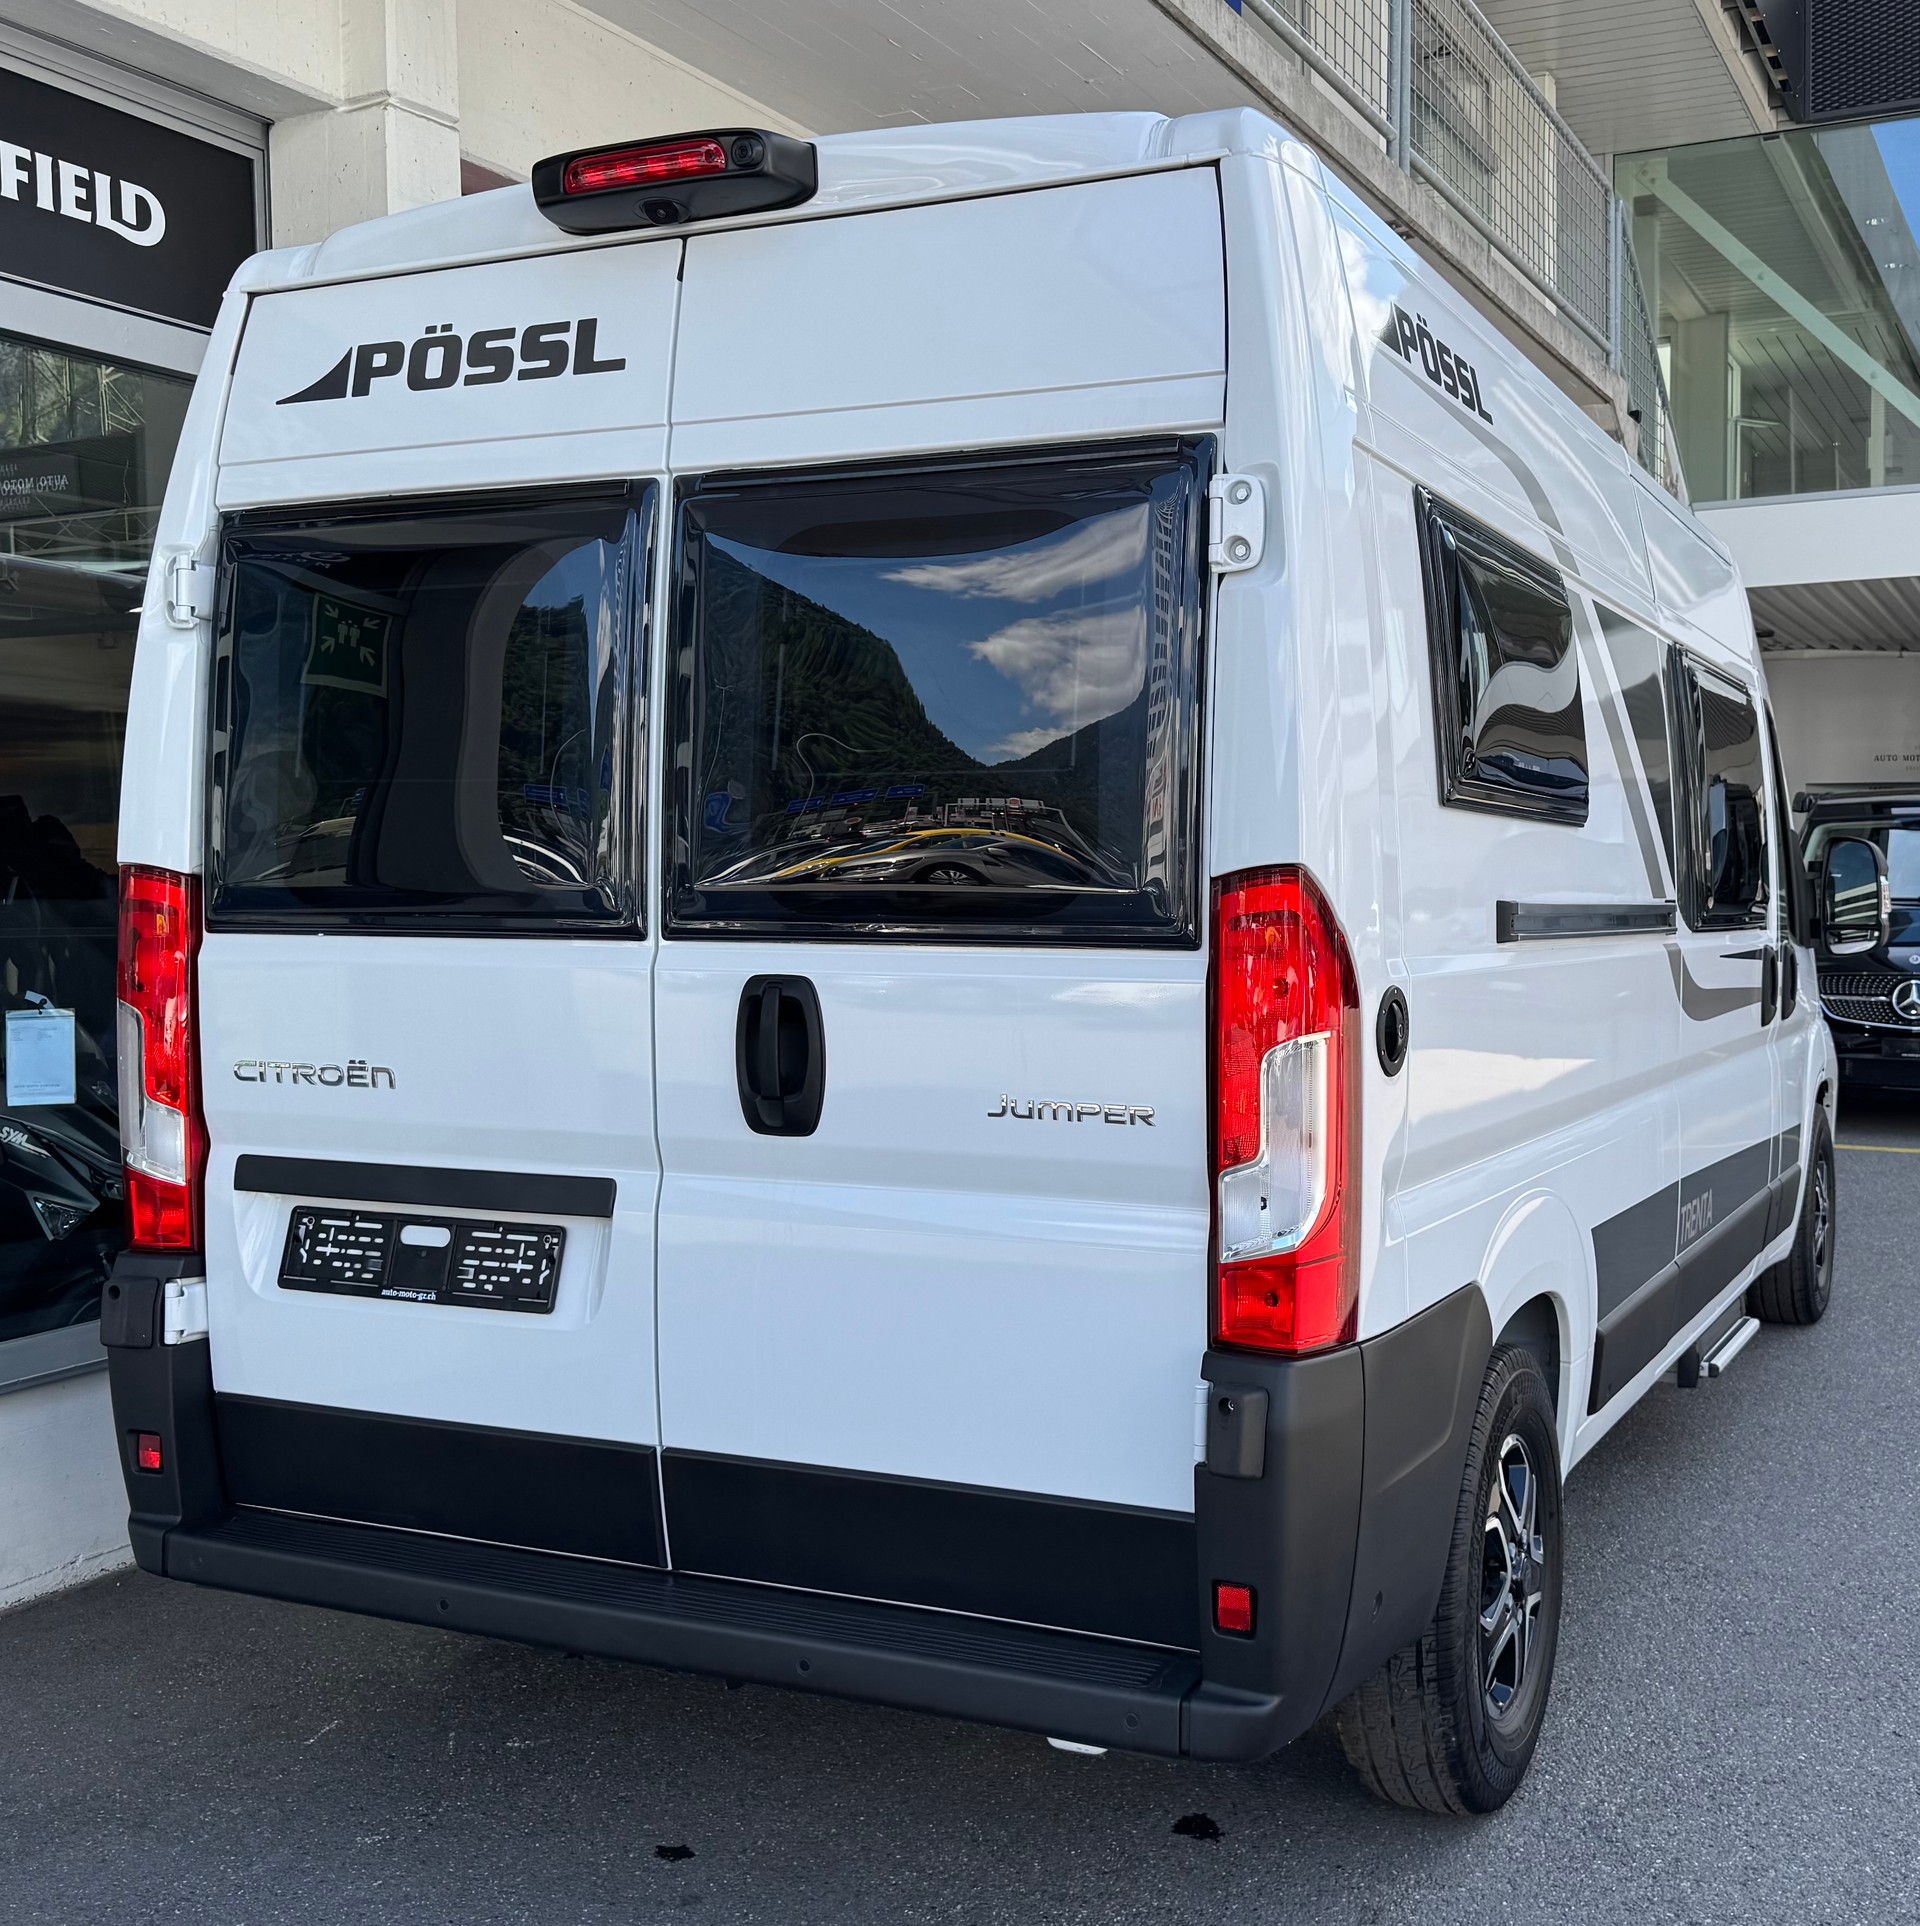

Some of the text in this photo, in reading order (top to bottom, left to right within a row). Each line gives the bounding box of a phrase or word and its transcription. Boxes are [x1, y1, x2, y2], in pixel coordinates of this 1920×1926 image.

[0, 139, 166, 247] FIELD
[351, 317, 627, 398] PÖSSL
[1393, 302, 1494, 426] PÖSSL
[1873, 754, 1898, 762] AUTO
[233, 1059, 397, 1090] CITROËN
[987, 1093, 1156, 1127] JUMPER
[1681, 1188, 1713, 1245] TRENTA
